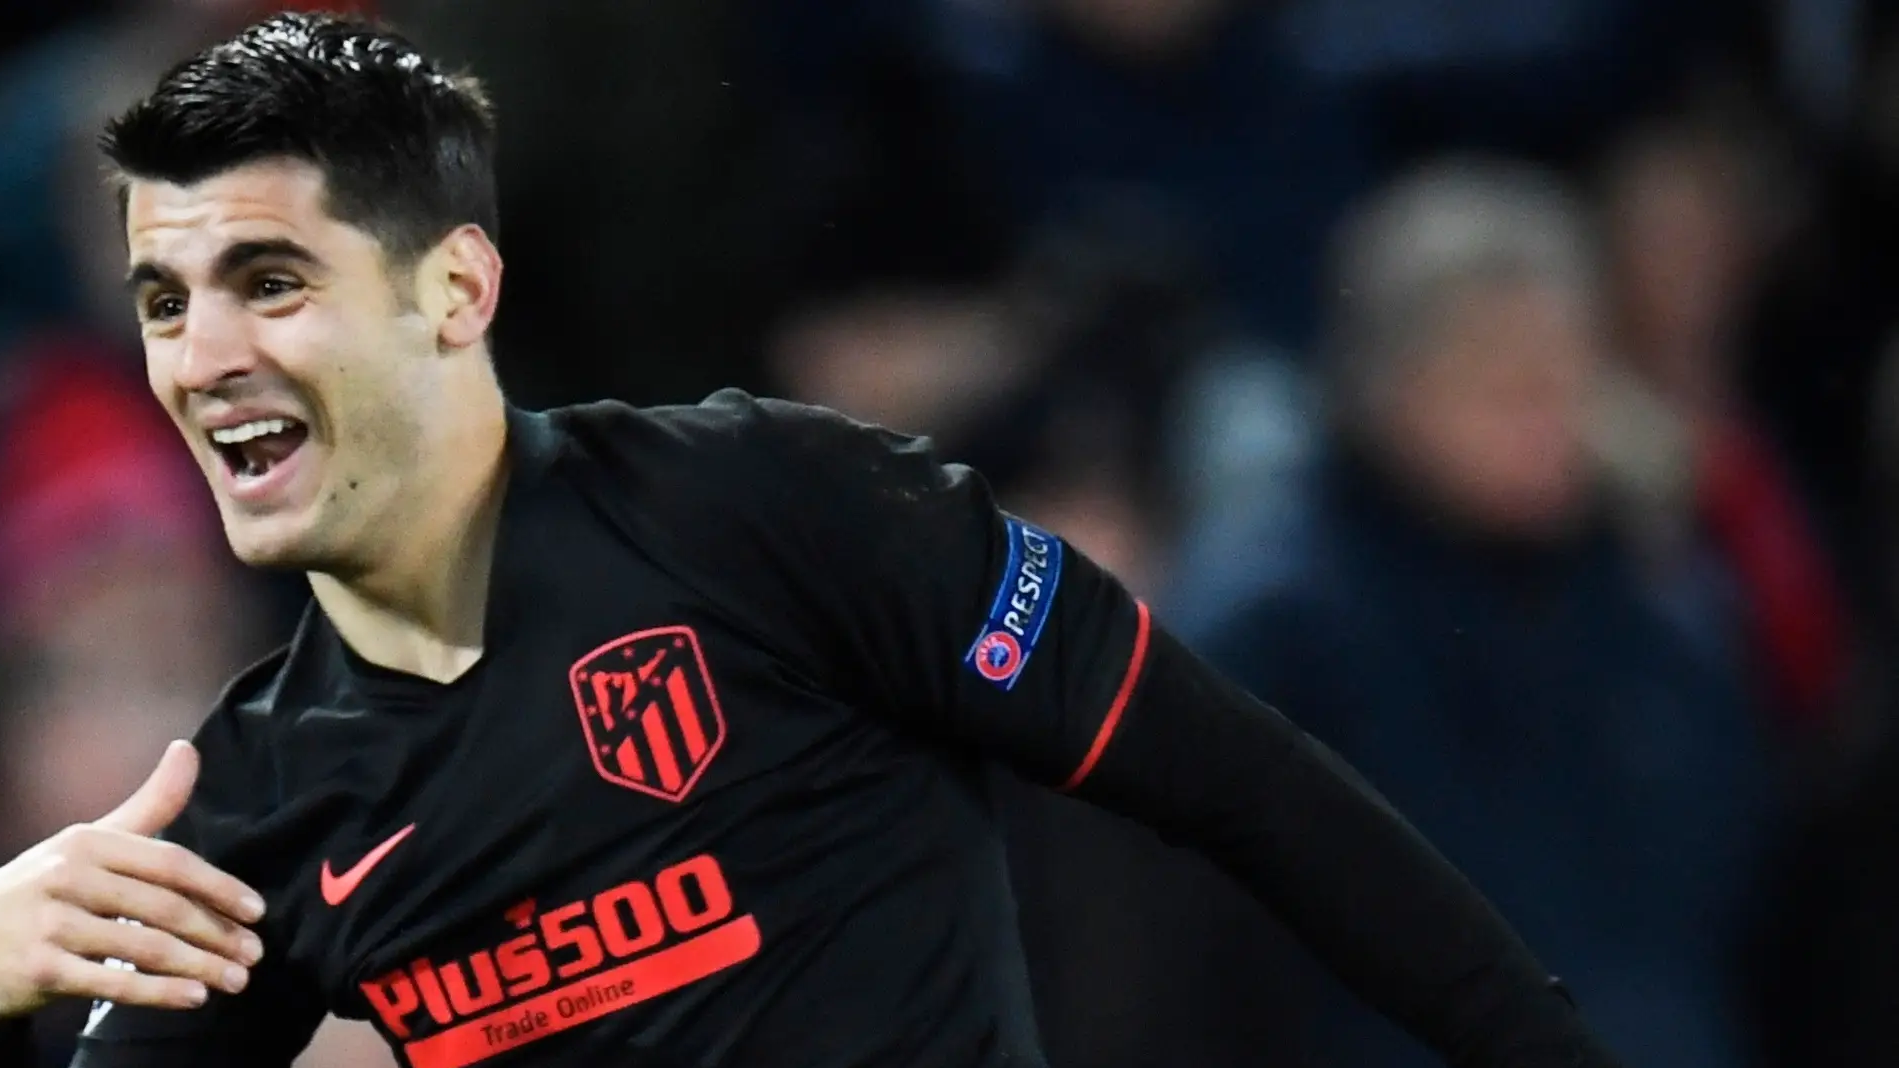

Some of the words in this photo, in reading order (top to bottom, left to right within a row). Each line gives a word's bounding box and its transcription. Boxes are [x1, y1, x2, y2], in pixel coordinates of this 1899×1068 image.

[1003, 525, 1049, 636] RESPECT
[359, 853, 734, 1040] Plus500
[480, 1009, 549, 1047] Trade
[556, 979, 635, 1019] Online
